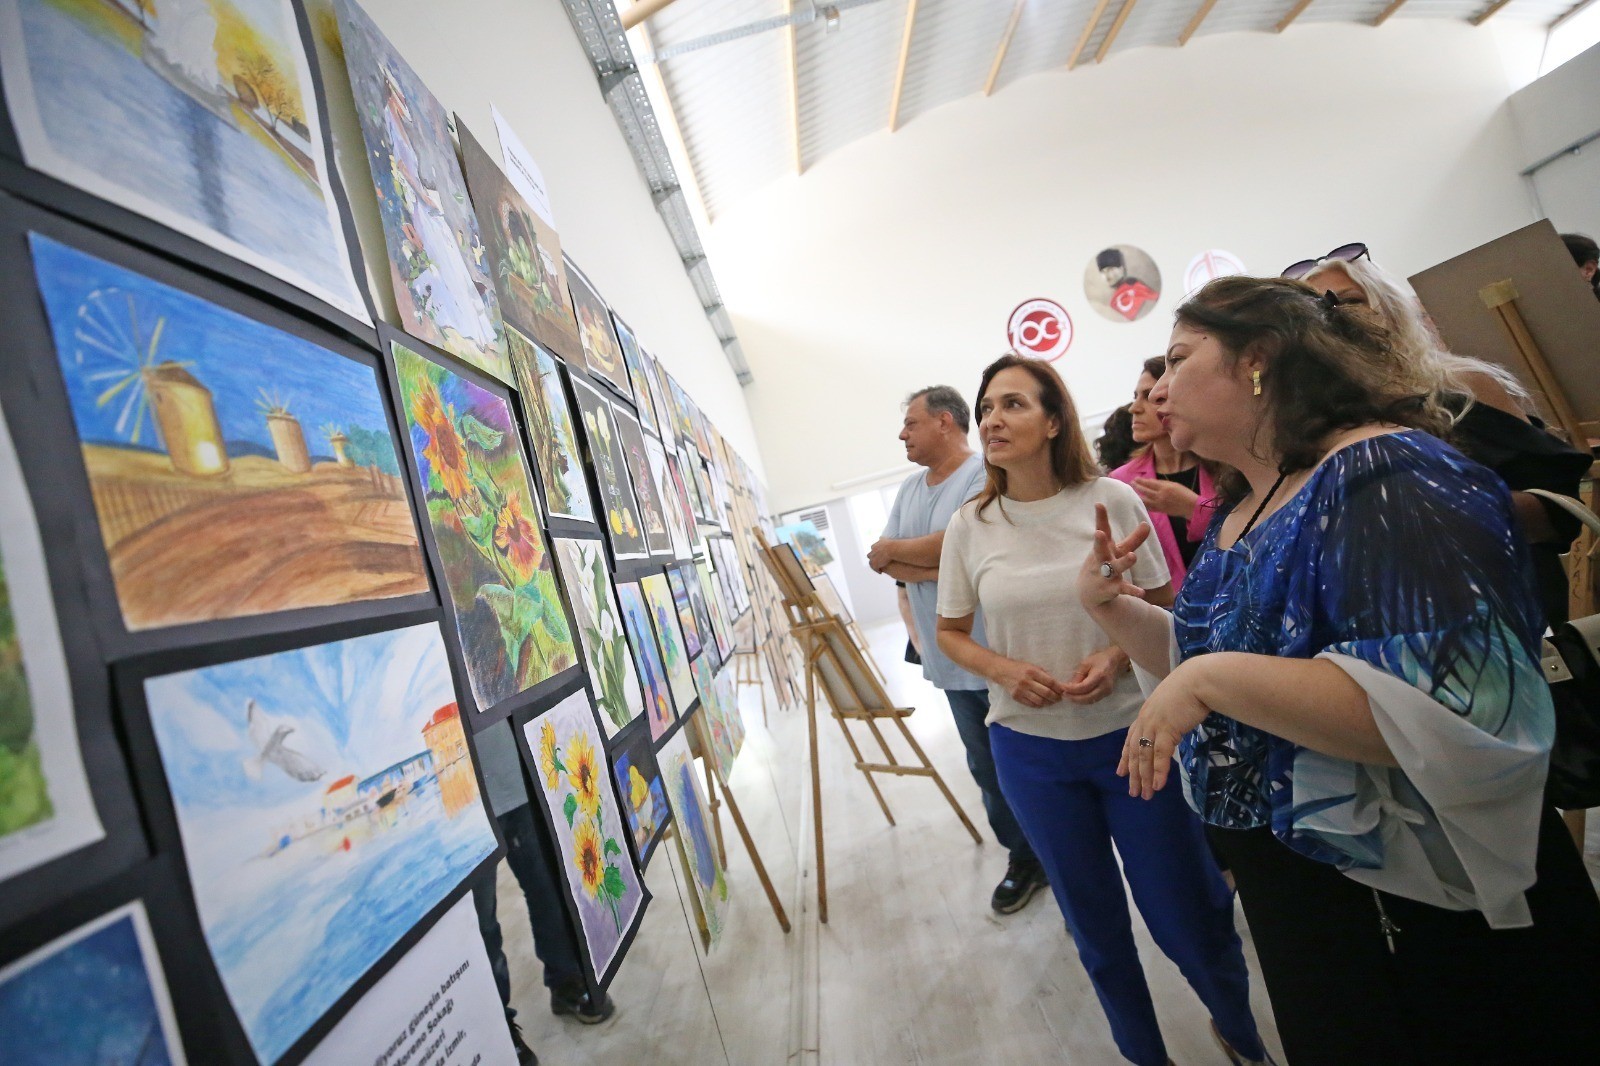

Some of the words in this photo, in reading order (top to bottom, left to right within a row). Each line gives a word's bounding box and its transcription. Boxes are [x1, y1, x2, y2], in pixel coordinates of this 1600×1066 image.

[408, 992, 440, 1035] güneşin
[440, 960, 470, 994] batışını
[427, 998, 454, 1033] Sokağı
